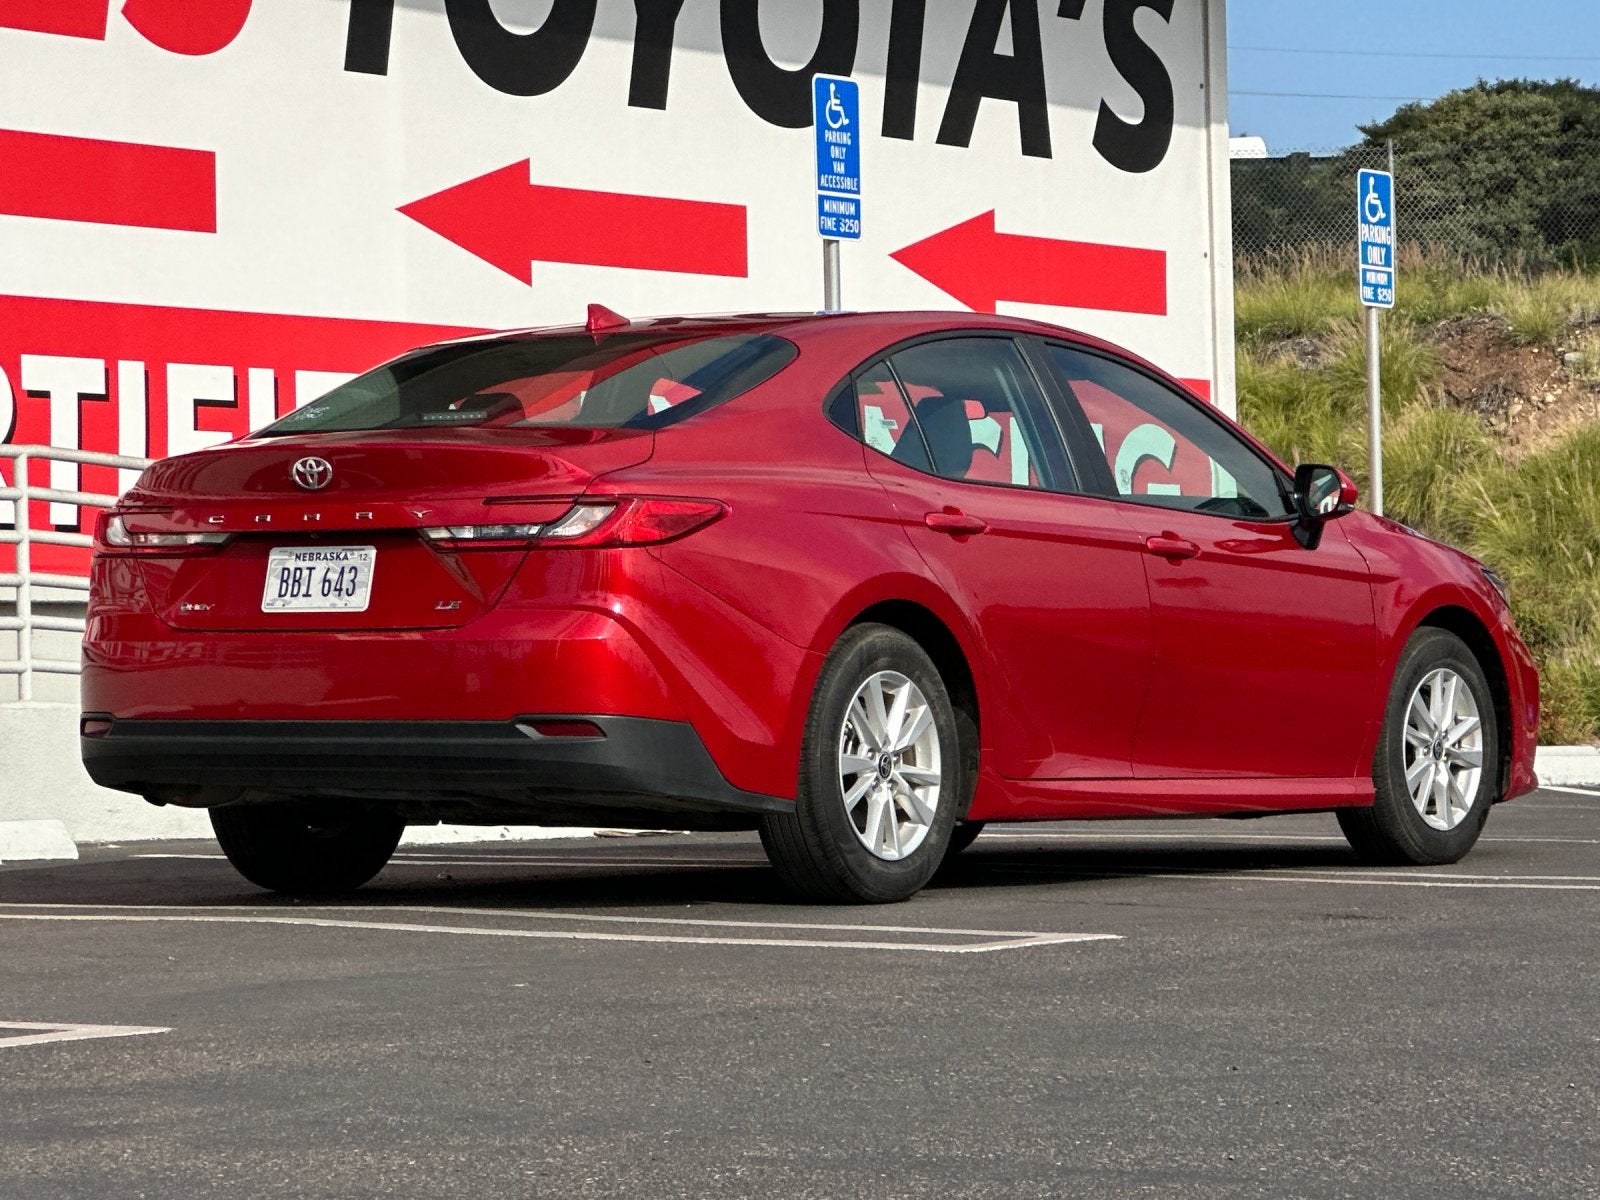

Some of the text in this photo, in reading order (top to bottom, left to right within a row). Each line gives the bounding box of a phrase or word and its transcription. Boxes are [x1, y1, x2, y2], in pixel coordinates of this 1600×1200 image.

[825, 130, 851, 146] PARKING
[830, 145, 847, 160] ONLY
[832, 160, 845, 174] VAN
[820, 174, 858, 191] ACCESSIBLE
[823, 199, 856, 216] MINIMUM
[820, 216, 859, 233] FINE $250
[1361, 223, 1391, 246] PARKING
[1367, 245, 1386, 266] ONLY
[294, 552, 349, 562] NEBRASKA
[359, 553, 368, 561] 12
[278, 565, 358, 598] BBI 643
[434, 600, 462, 610] LE
